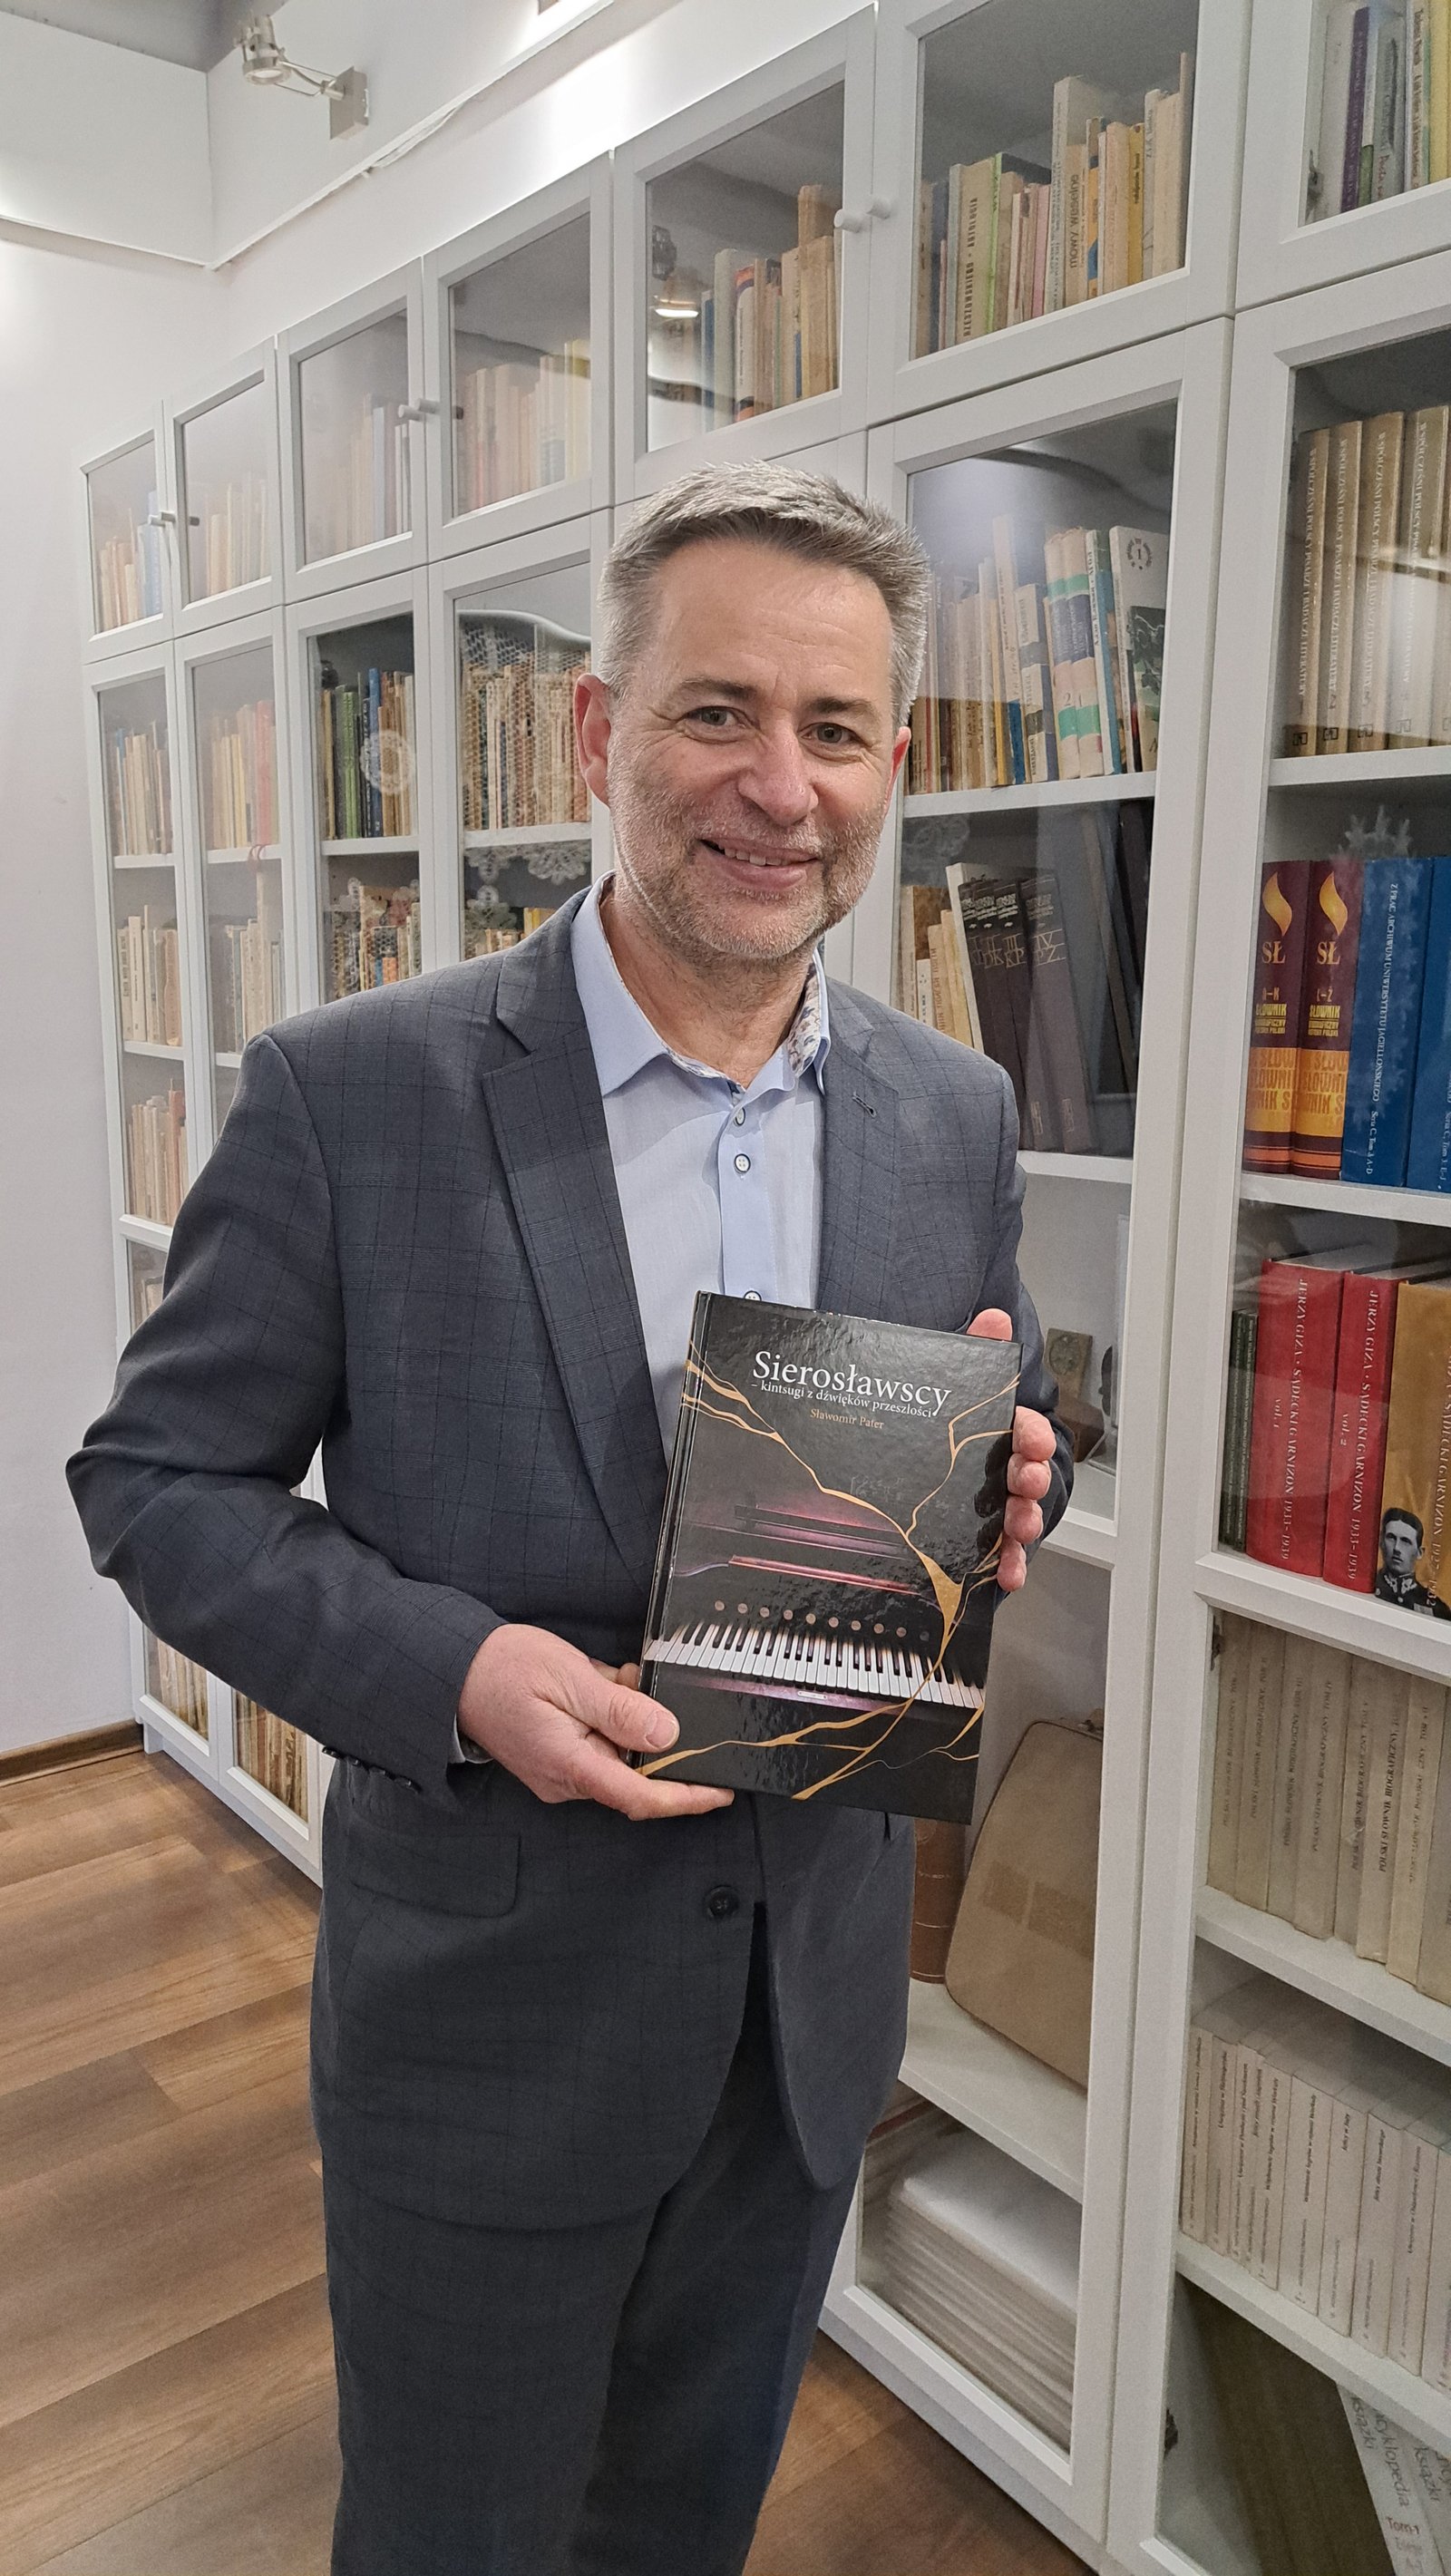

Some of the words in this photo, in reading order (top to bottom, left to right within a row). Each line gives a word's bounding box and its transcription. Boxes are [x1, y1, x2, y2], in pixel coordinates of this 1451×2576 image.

[1067, 174, 1079, 227] weselne
[1388, 890, 1397, 912] PRAC
[1261, 941, 1286, 964] SŁ
[1317, 941, 1340, 965] SŁ
[1384, 913, 1396, 961] ARCHIWUM
[1256, 1004, 1287, 1016] SŁOWNIK
[1310, 1005, 1341, 1018] SŁOWNIK
[1297, 1278, 1308, 1319] JERZY
[1367, 1290, 1378, 1332] JERZY
[1294, 1324, 1305, 1356] GIZA
[1363, 1337, 1375, 1369] GIZA
[753, 1350, 951, 1417] Sierosławscy
[761, 1380, 804, 1399] kintsugi
[807, 1390, 813, 1399] z
[815, 1389, 871, 1408] dźwięków
[810, 1408, 857, 1424] Sławomir
[859, 1417, 885, 1430] Pater
[1284, 1426, 1298, 1495] GARNIZON
[1352, 1444, 1367, 1512] GARNIZON
[1433, 1464, 1448, 1536] GARNIZON
[1378, 1842, 1388, 1872] POLSKI
[1372, 2409, 1410, 2507] cyklopedia
